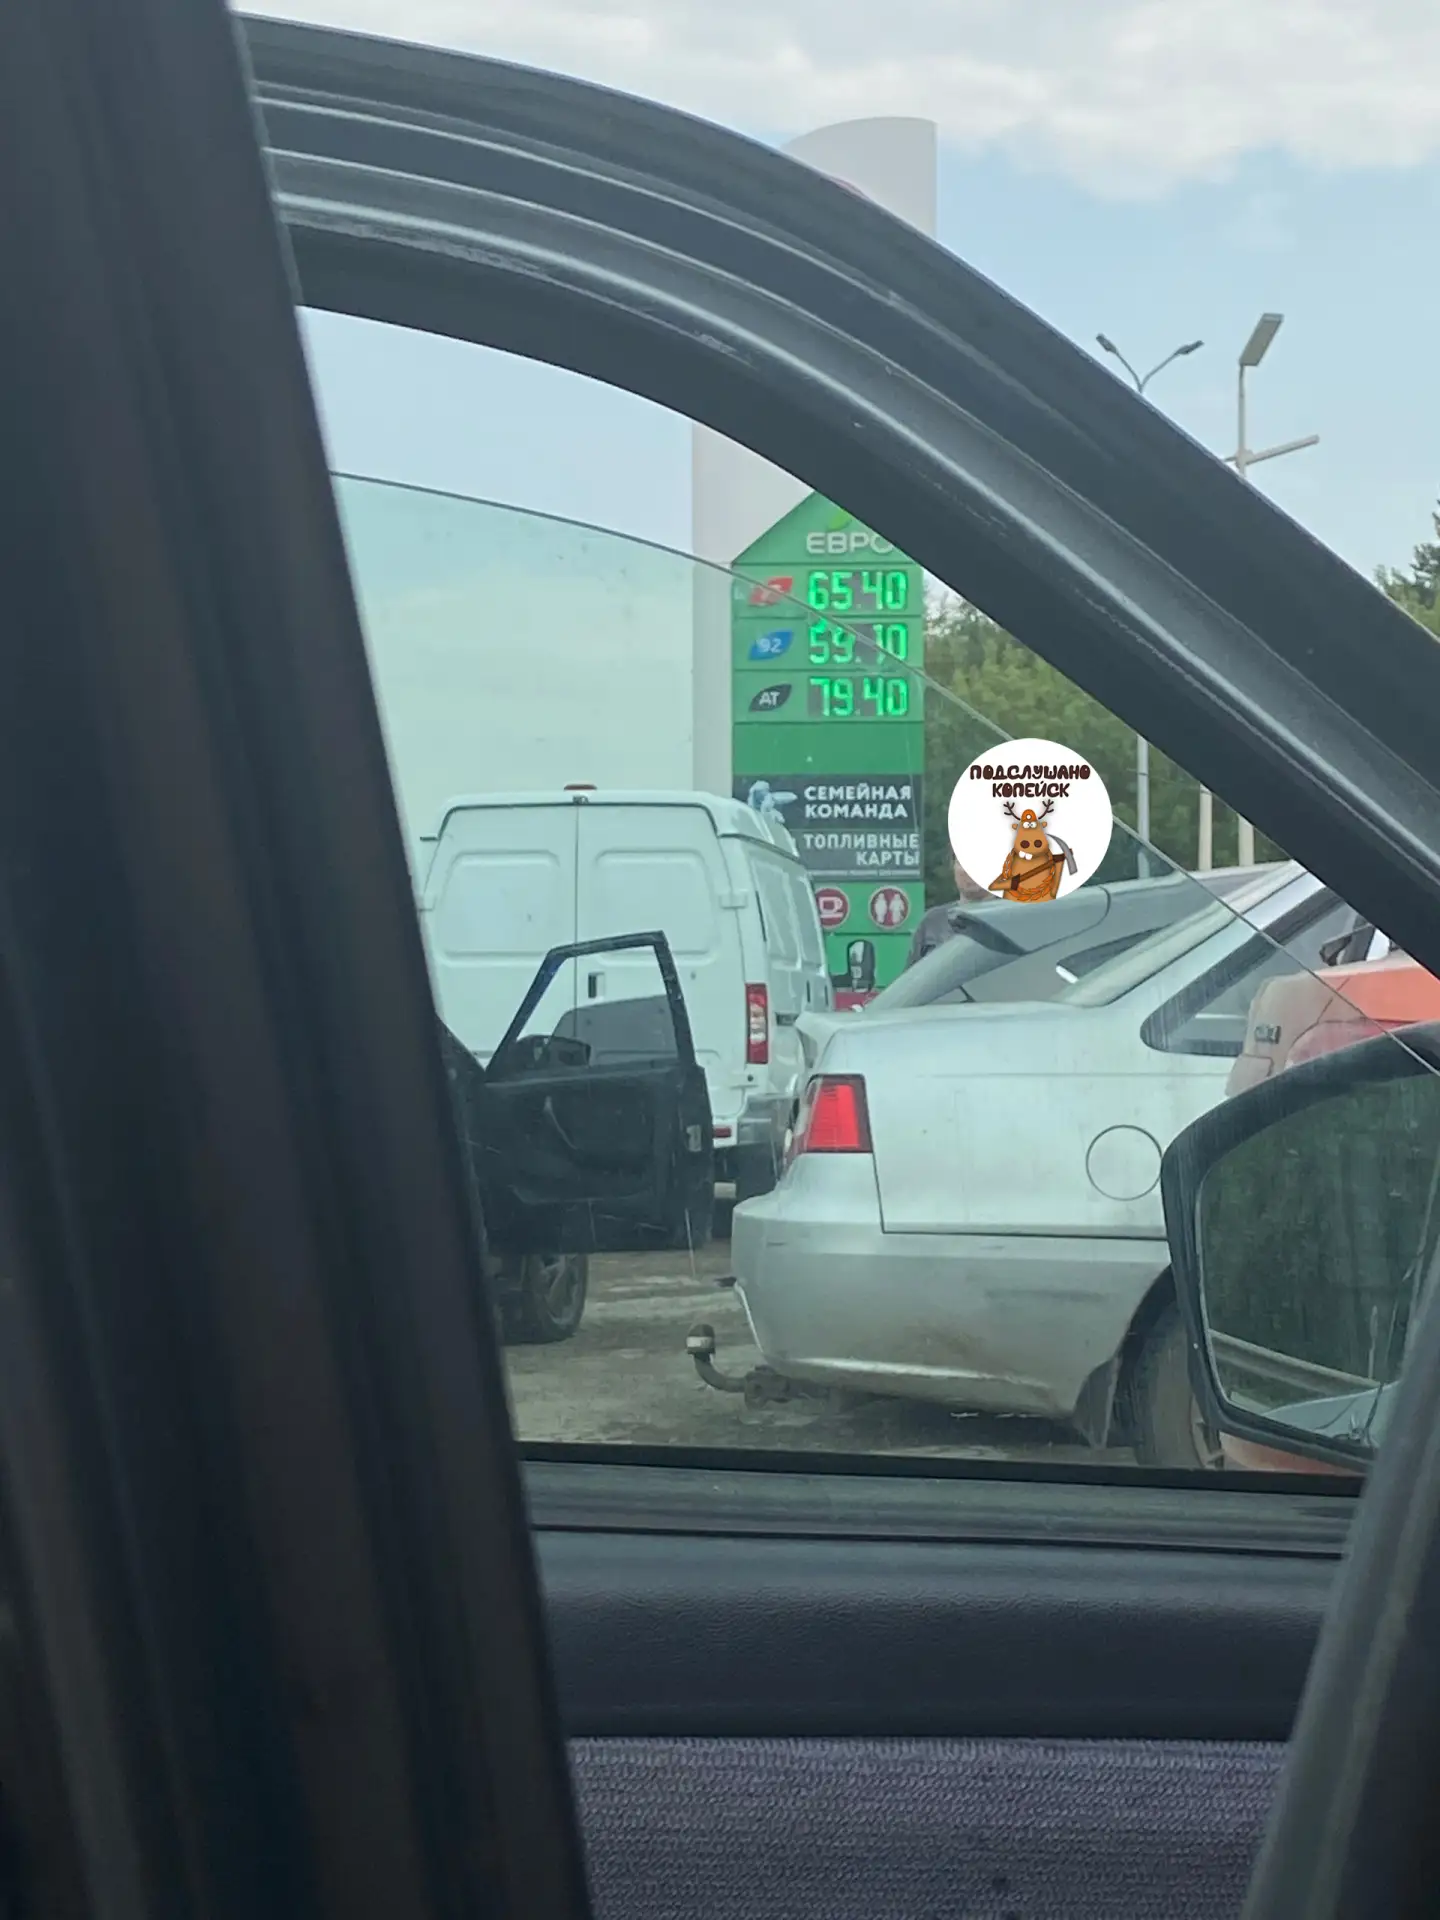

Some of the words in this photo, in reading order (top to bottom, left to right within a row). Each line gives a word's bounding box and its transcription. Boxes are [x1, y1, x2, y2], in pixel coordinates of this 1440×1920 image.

[757, 637, 782, 653] 92
[804, 783, 911, 800] СЕМЕЙНАЯ
[804, 804, 908, 819] КОМАНДА
[804, 833, 919, 849] ТОПЛИВНЫЕ
[856, 851, 920, 866] КАРТЫ
